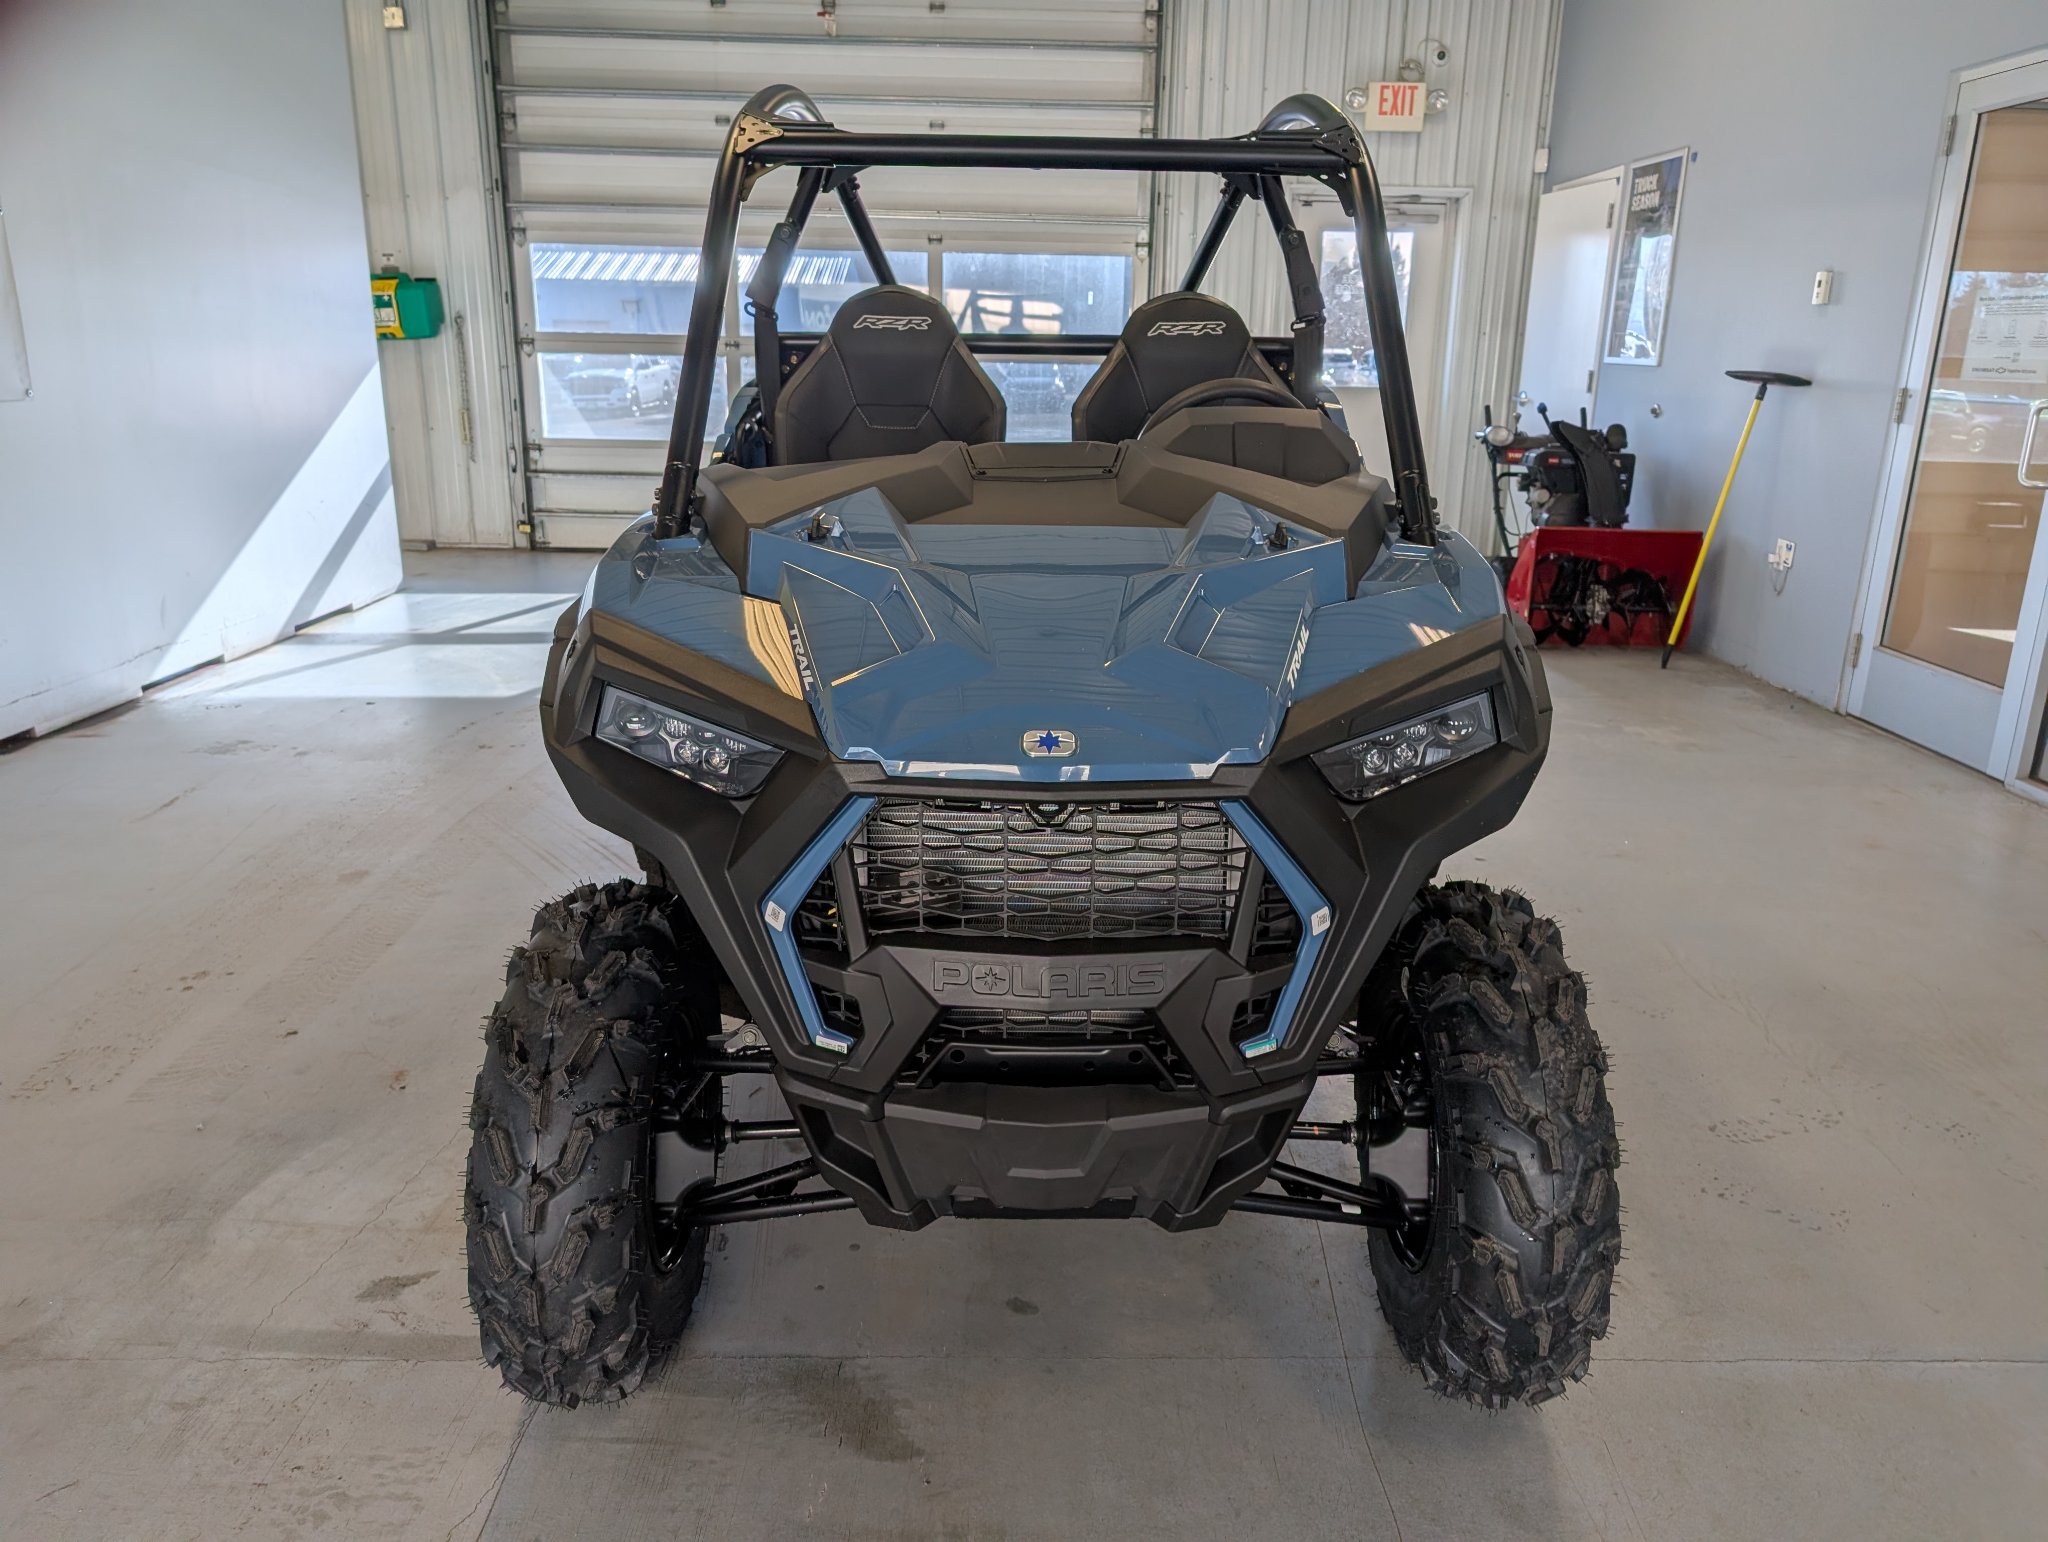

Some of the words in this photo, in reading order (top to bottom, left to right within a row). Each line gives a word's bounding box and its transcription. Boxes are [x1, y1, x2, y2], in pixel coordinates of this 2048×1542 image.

[1378, 84, 1418, 116] EXIT
[1633, 173, 1659, 195] TRUCK
[1630, 190, 1661, 212] SEASON
[853, 314, 932, 331] RZR
[1147, 321, 1226, 336] RZR
[789, 623, 814, 691] TRAIL
[1286, 624, 1310, 690] TRAIL
[932, 960, 1165, 999] POLARIS
